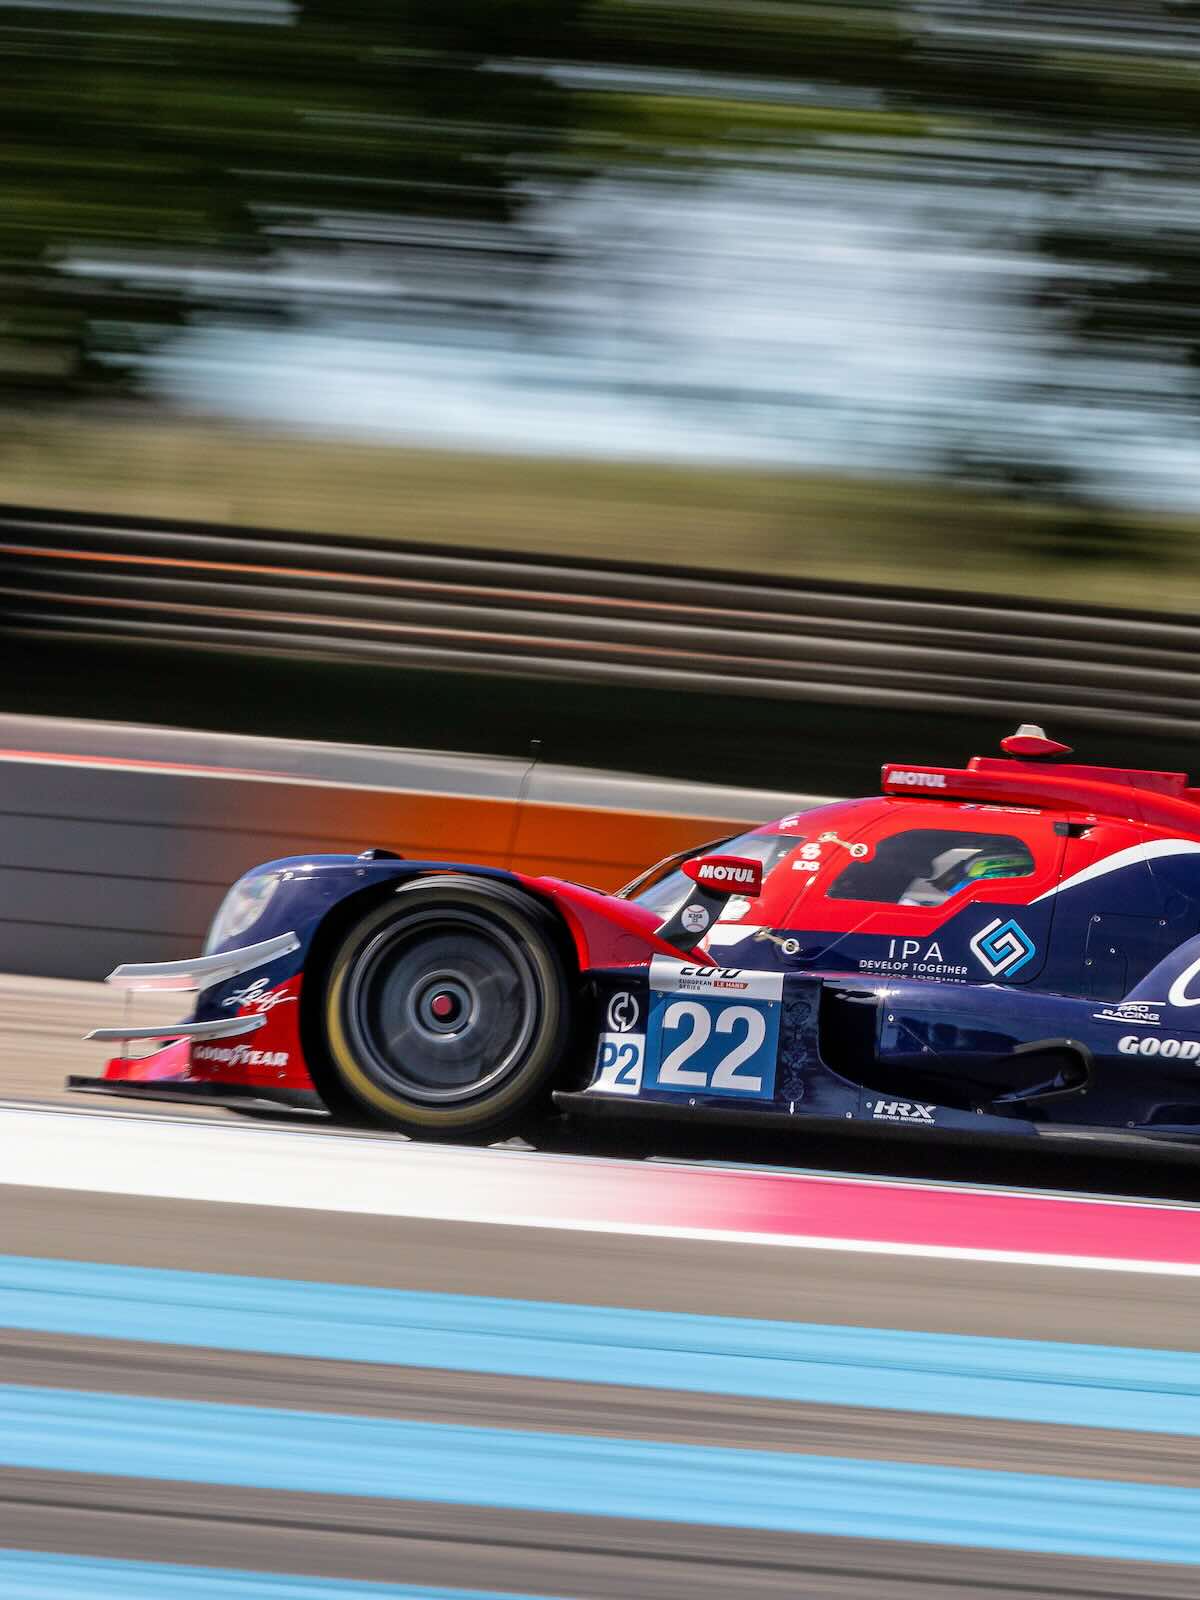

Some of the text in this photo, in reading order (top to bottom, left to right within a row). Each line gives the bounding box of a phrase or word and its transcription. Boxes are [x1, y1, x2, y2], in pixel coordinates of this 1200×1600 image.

[887, 770, 947, 788] MOTUL
[698, 864, 755, 883] MOTUL
[888, 939, 943, 962] IPA
[859, 959, 968, 975] DEVELOP TOGETHER
[1102, 1009, 1160, 1021] RACING
[192, 1045, 289, 1067] GOODYEAR
[657, 1001, 767, 1092] 22
[599, 1042, 640, 1085] P2
[874, 1100, 937, 1119] HRX
